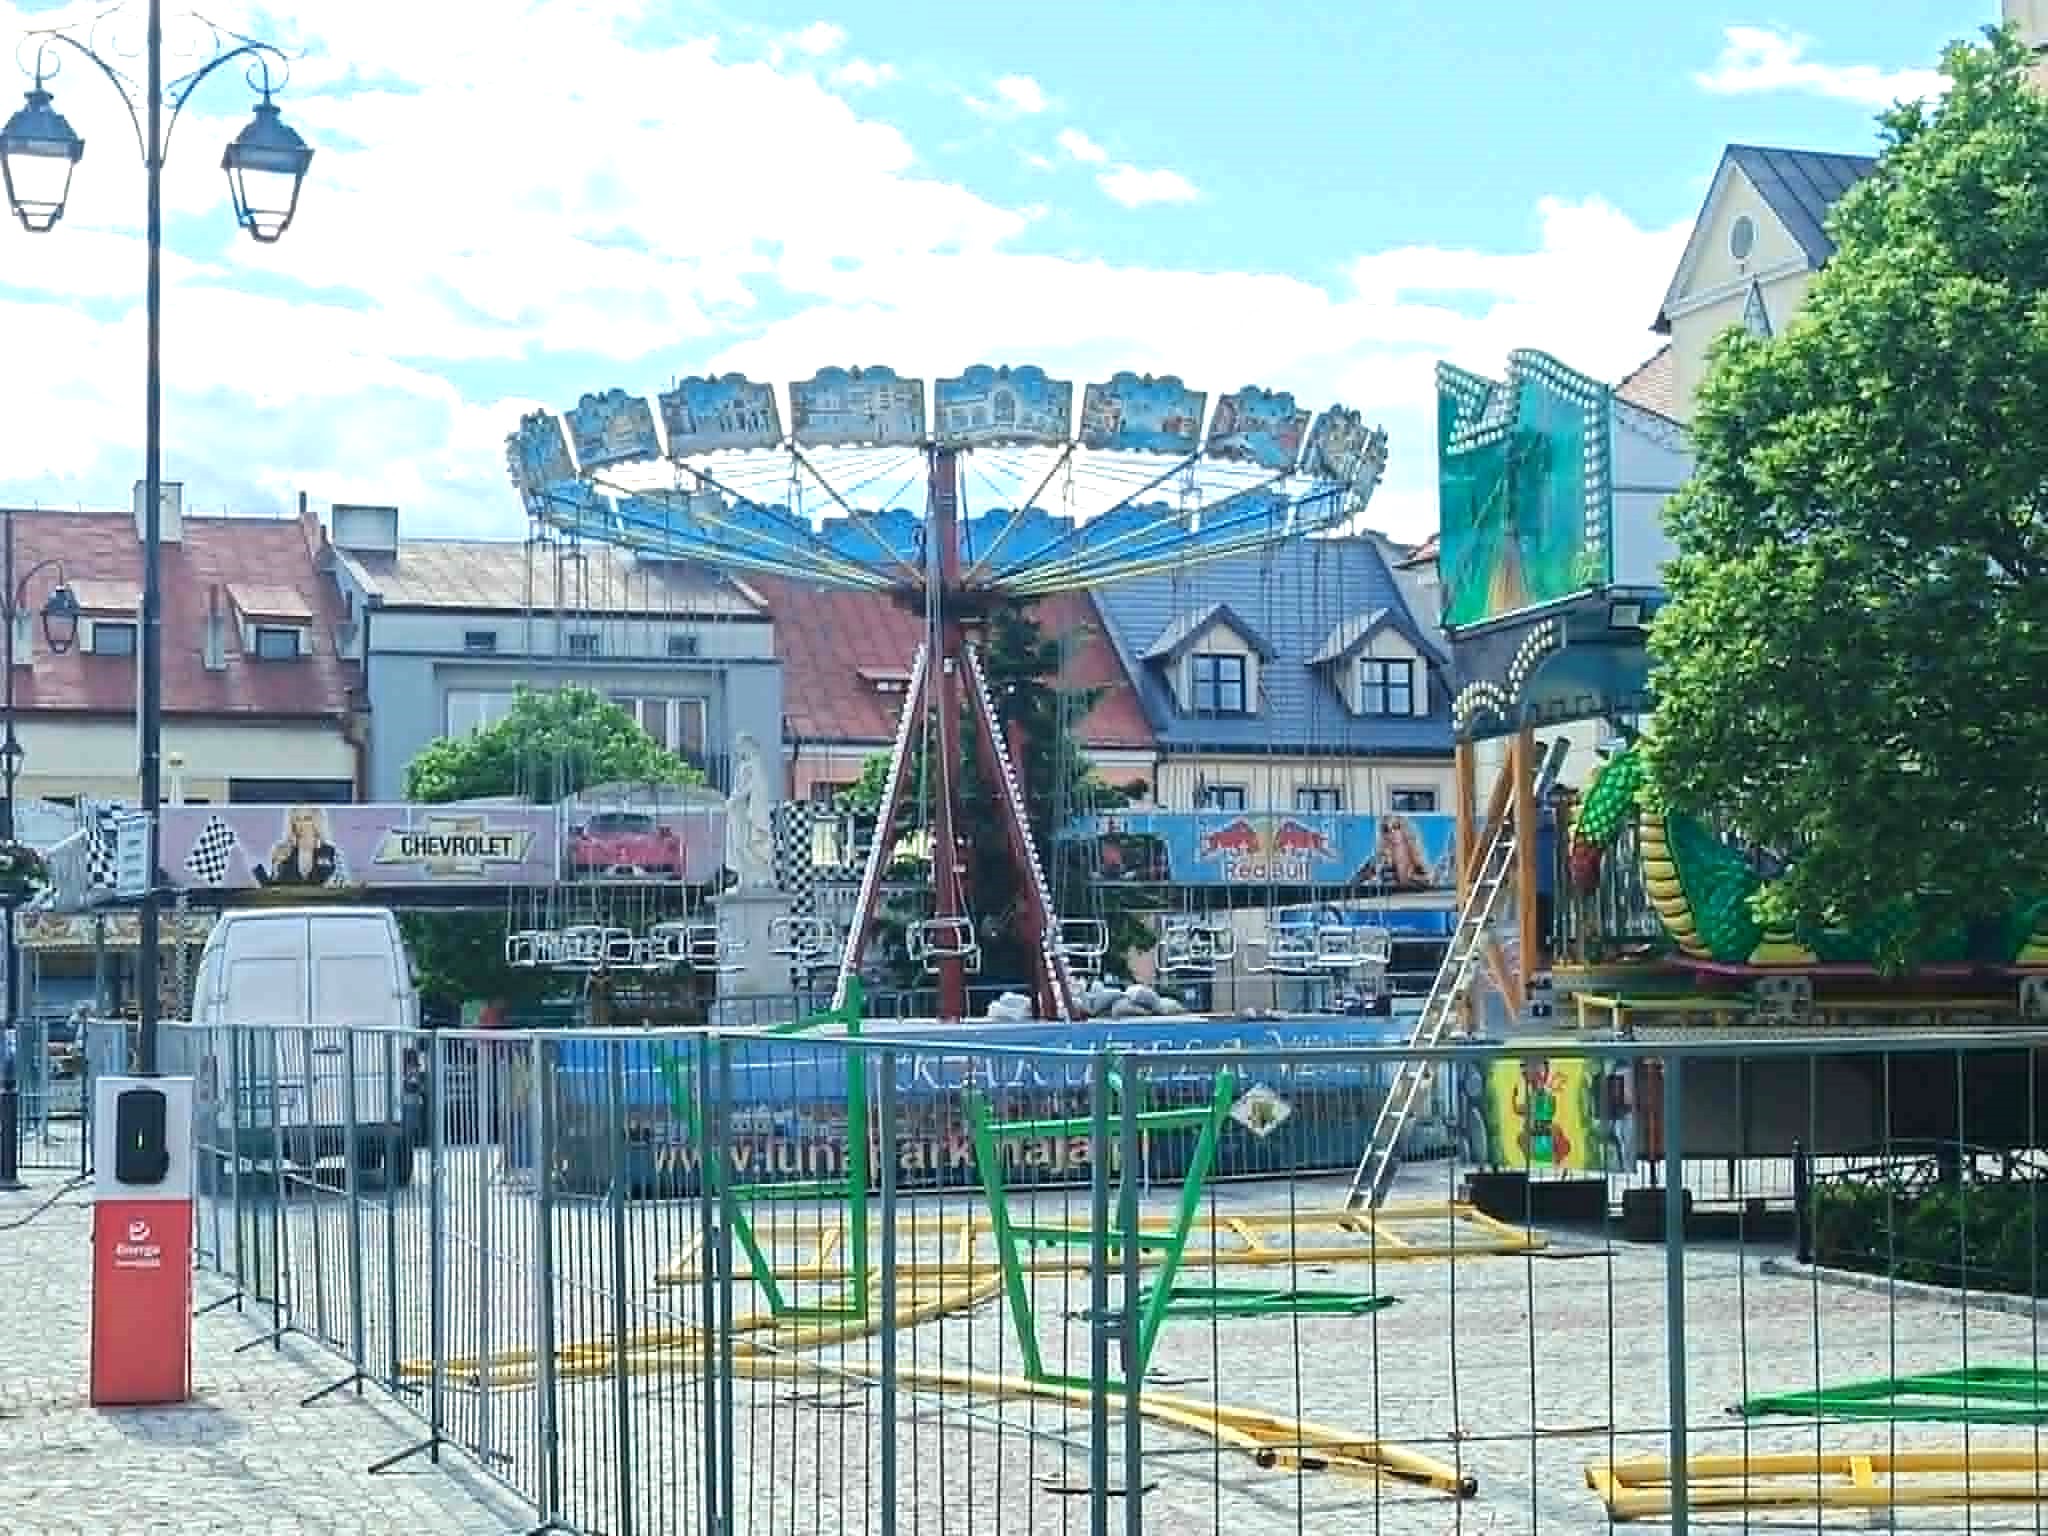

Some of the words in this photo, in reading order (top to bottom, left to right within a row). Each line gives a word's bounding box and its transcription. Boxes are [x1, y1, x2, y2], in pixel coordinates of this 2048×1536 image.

[400, 836, 513, 857] CHEVROLET
[1222, 863, 1267, 881] Red
[1270, 863, 1312, 881] Bull
